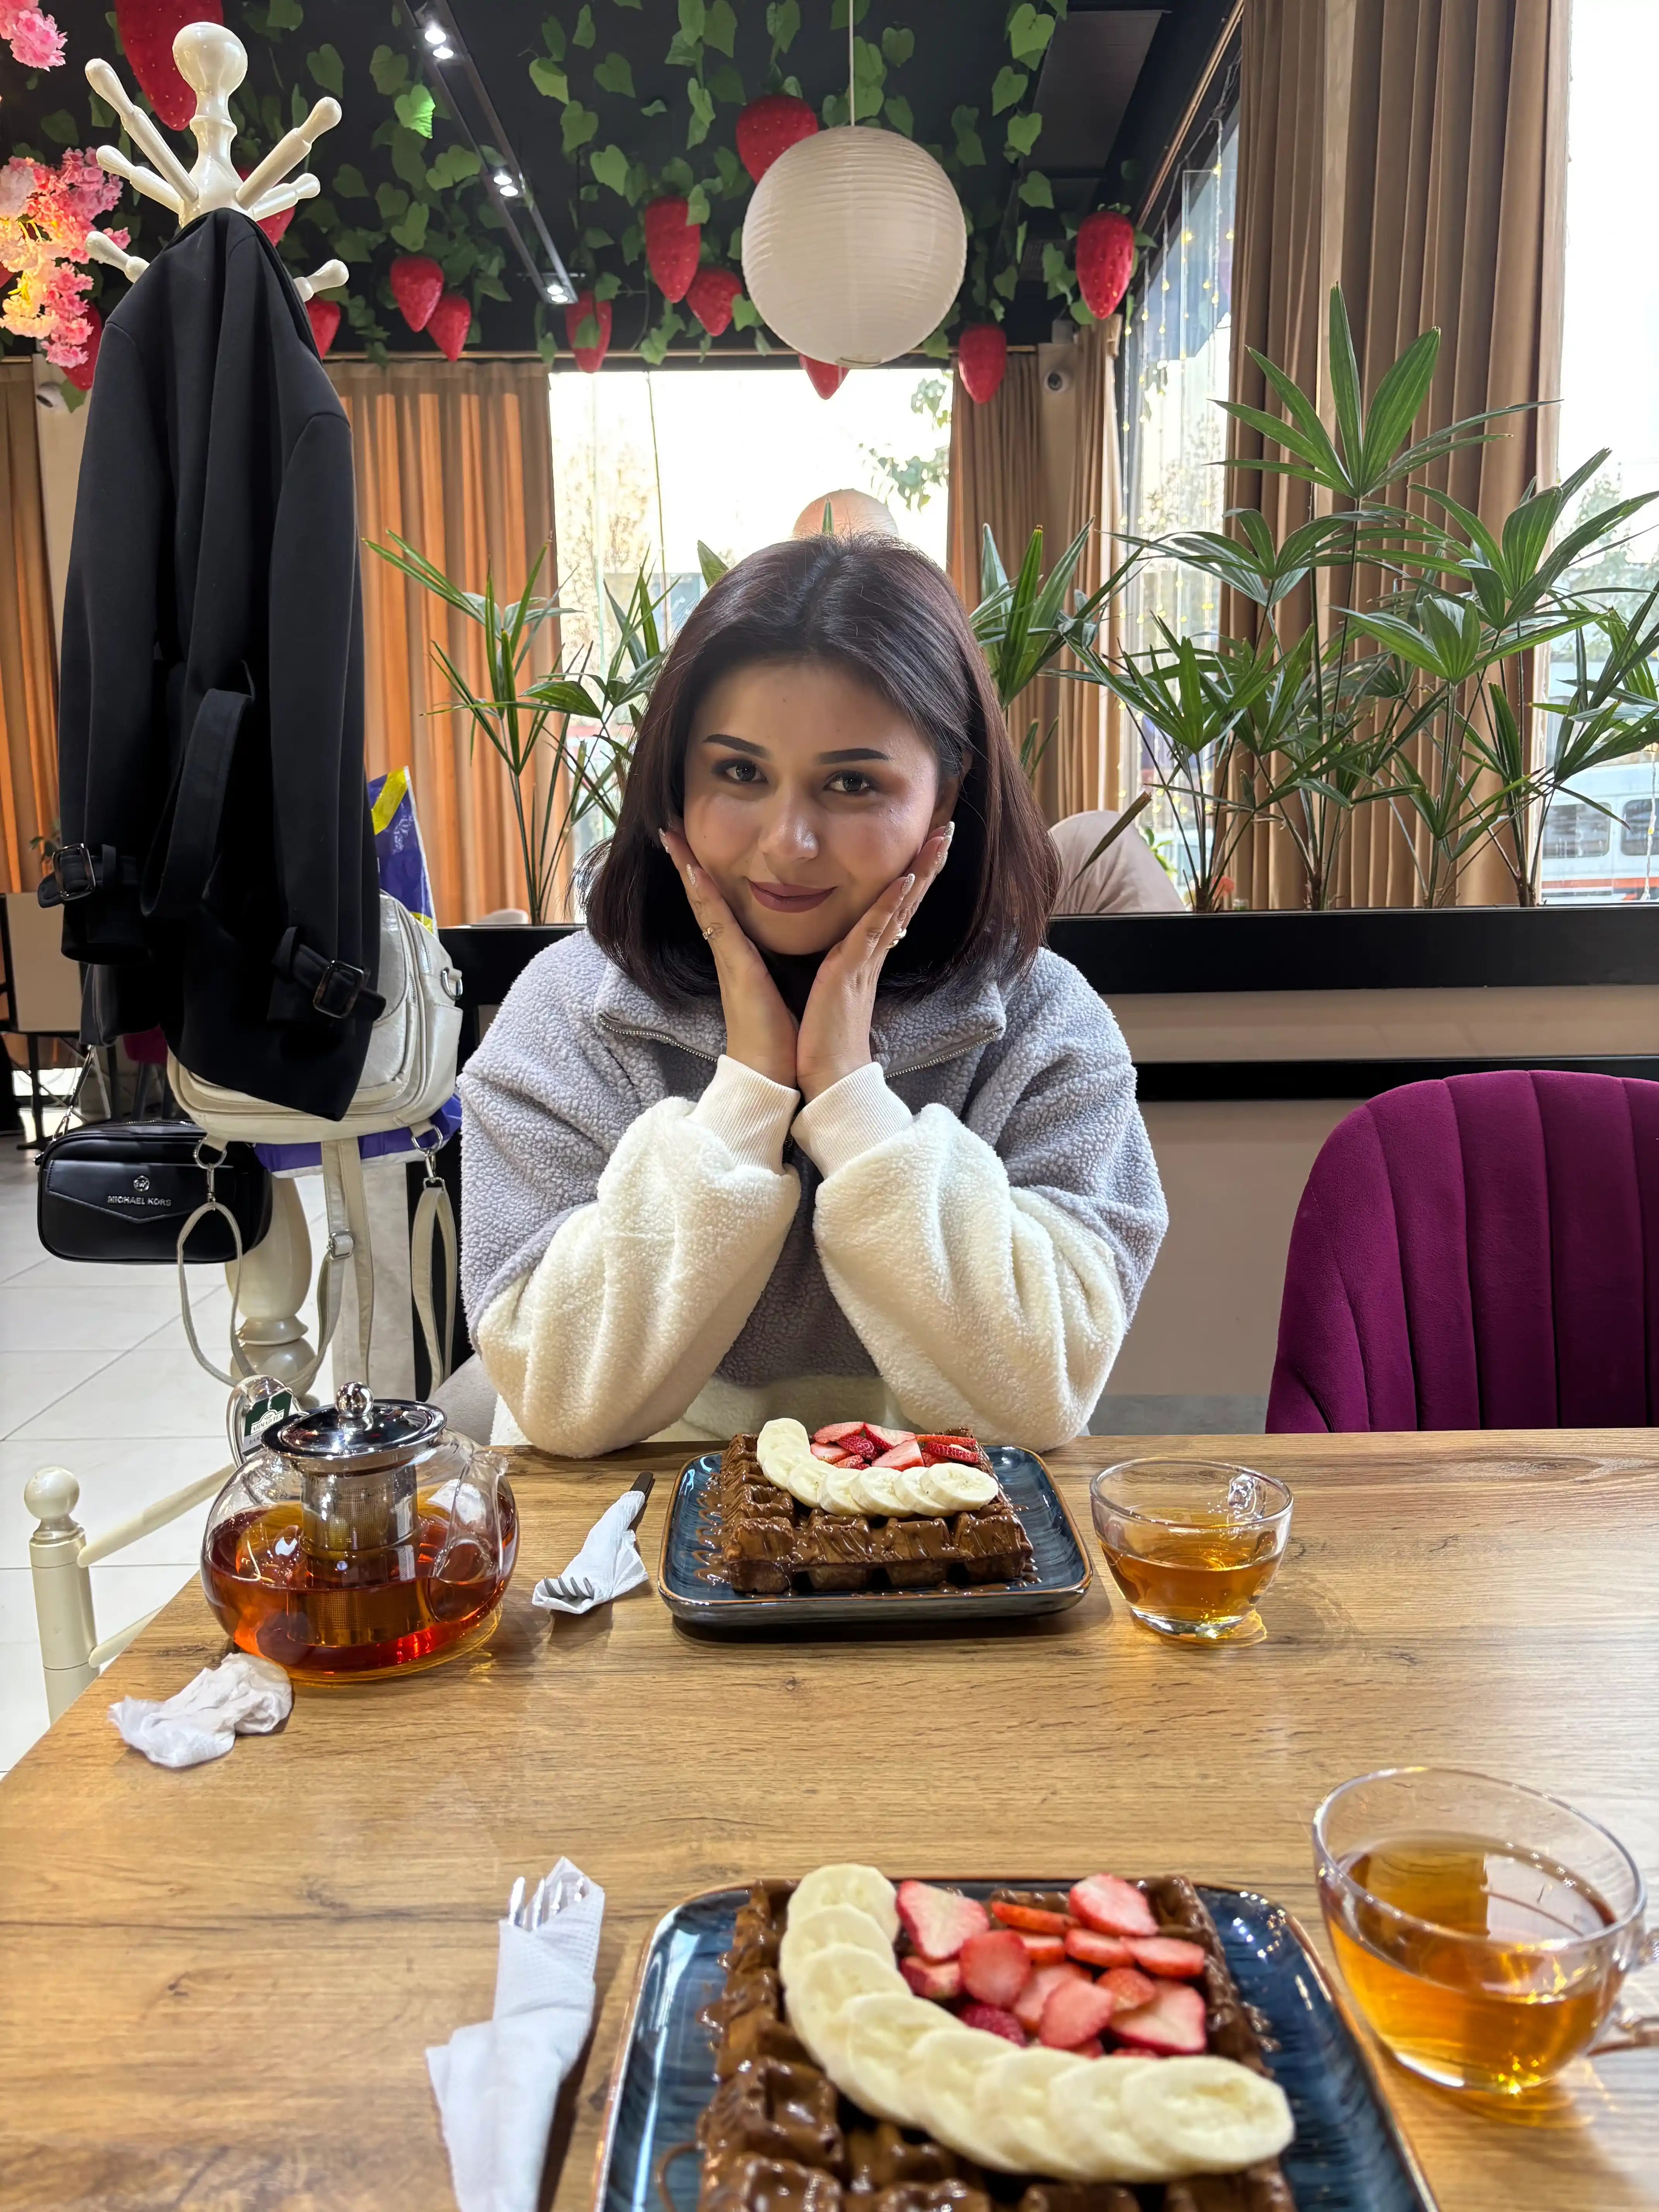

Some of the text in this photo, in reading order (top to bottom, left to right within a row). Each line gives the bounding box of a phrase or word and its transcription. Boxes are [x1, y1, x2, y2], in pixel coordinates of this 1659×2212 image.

[107, 1195, 172, 1206] MICHAEL KORS
[252, 1414, 283, 1431] AHMAD TEA
[249, 1436, 261, 1445] EAR
